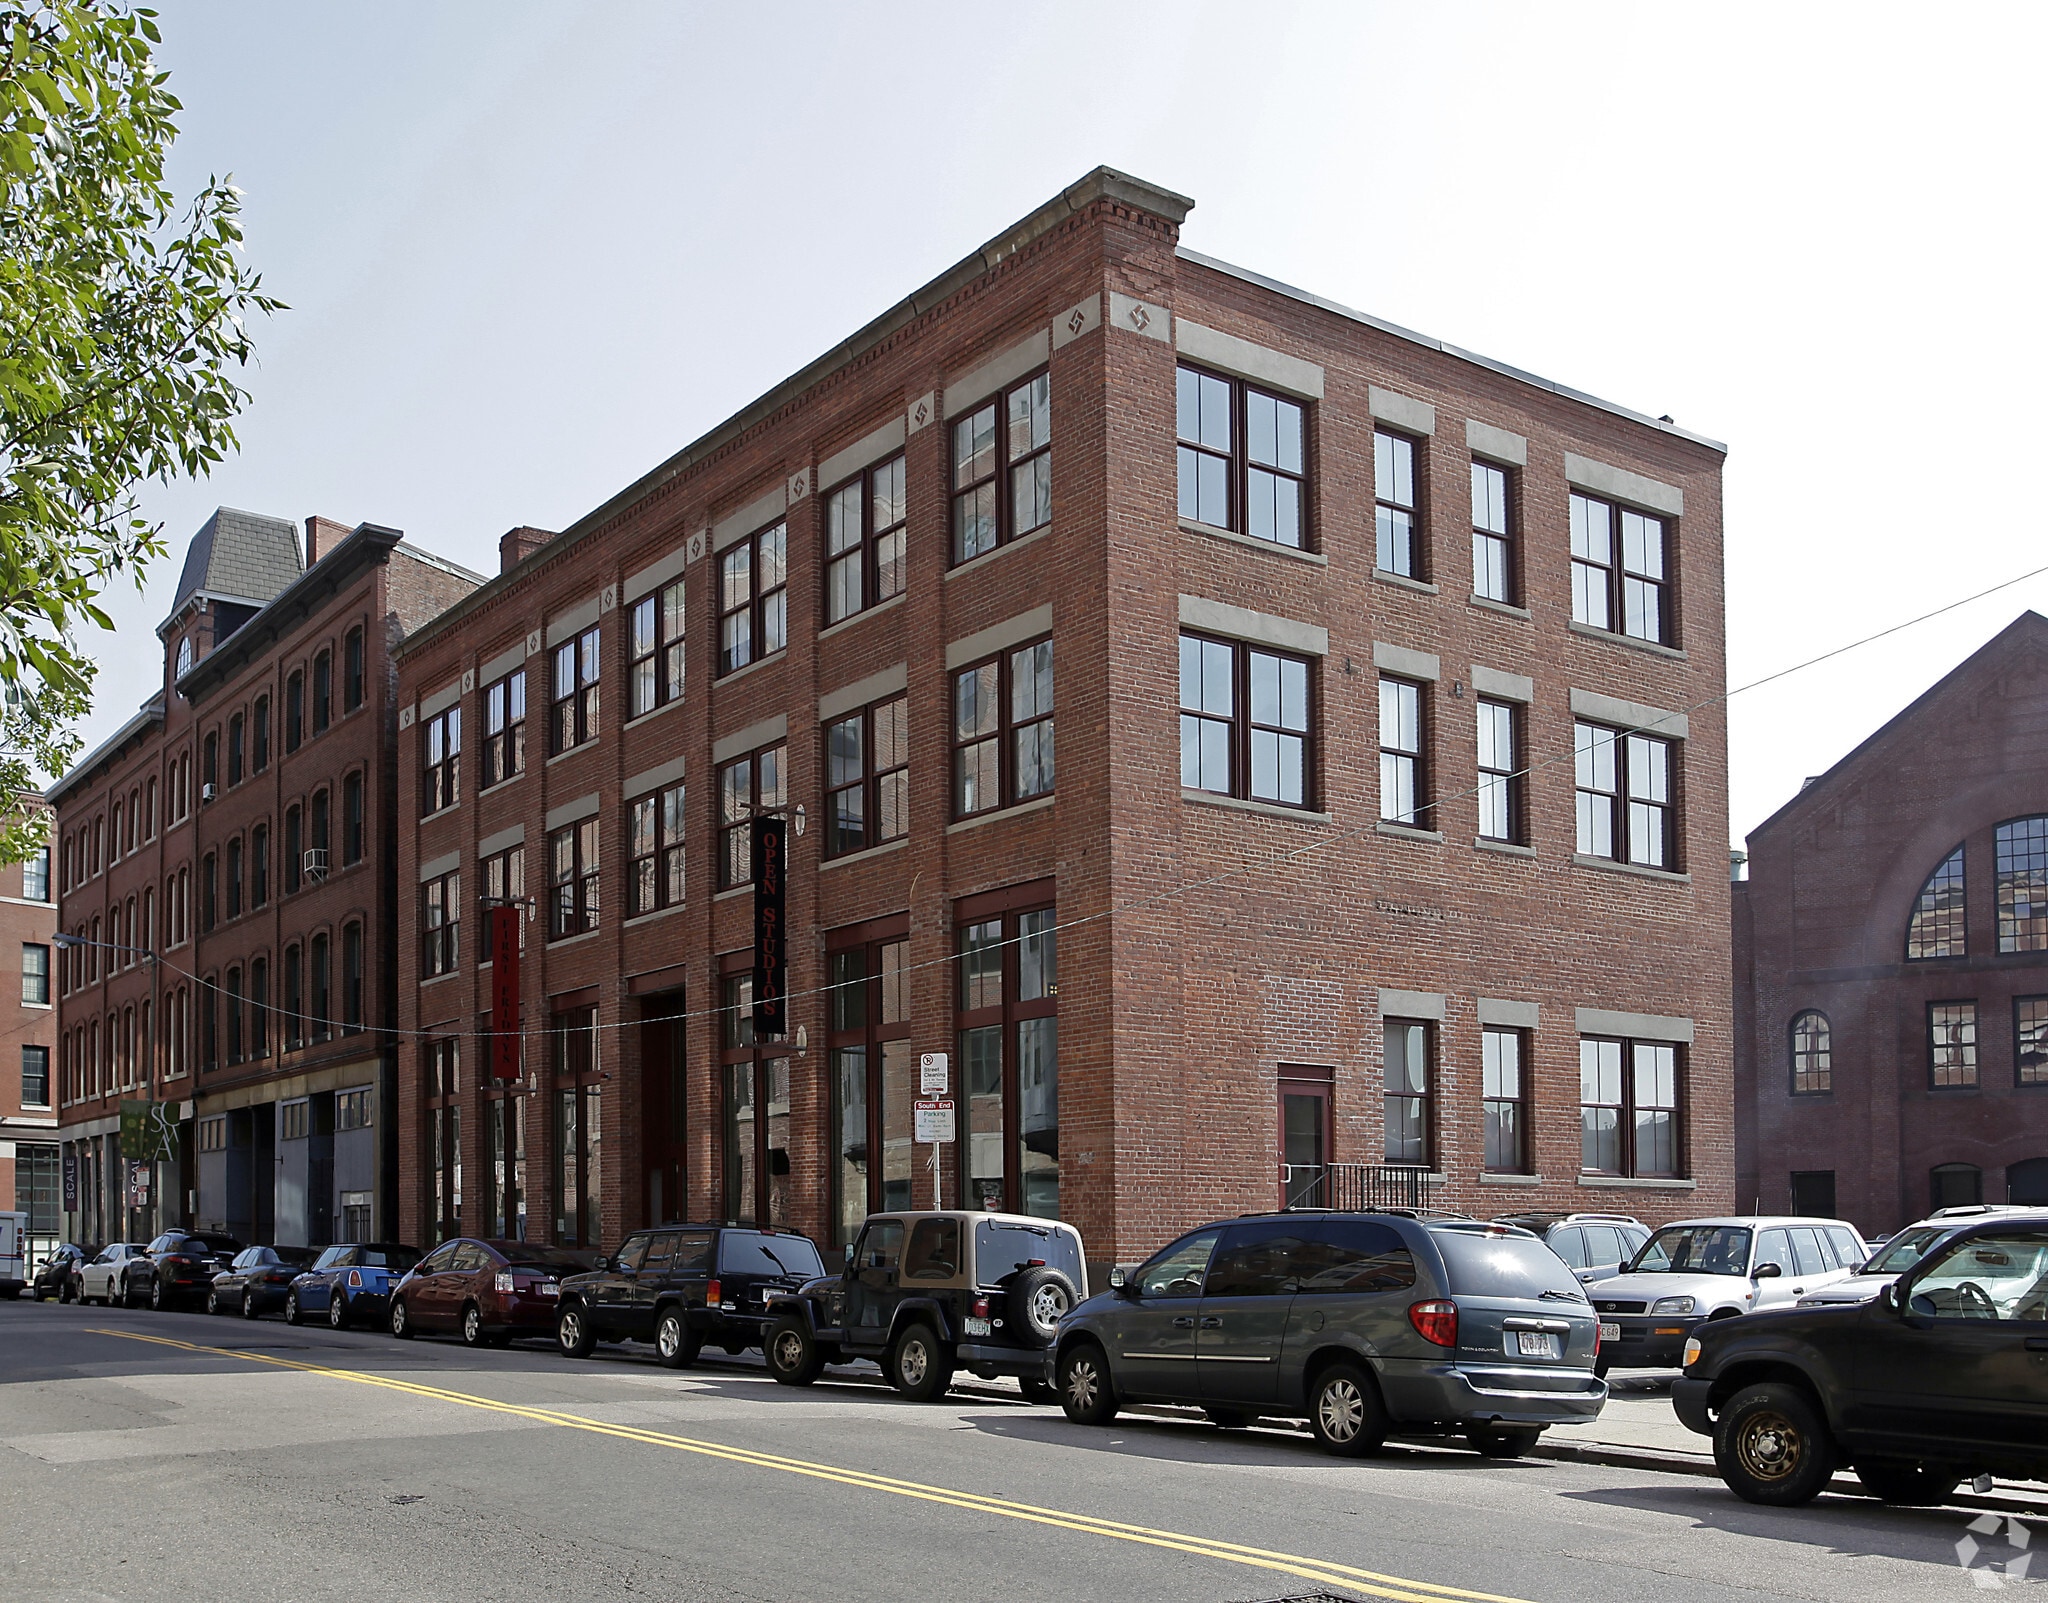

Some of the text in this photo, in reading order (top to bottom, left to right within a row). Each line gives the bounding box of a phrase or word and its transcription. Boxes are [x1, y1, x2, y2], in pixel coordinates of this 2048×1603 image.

[763, 833, 777, 1016] OPEN STUDIOS
[66, 1159, 75, 1199] SCALE
[131, 1159, 140, 1193] SCAL
